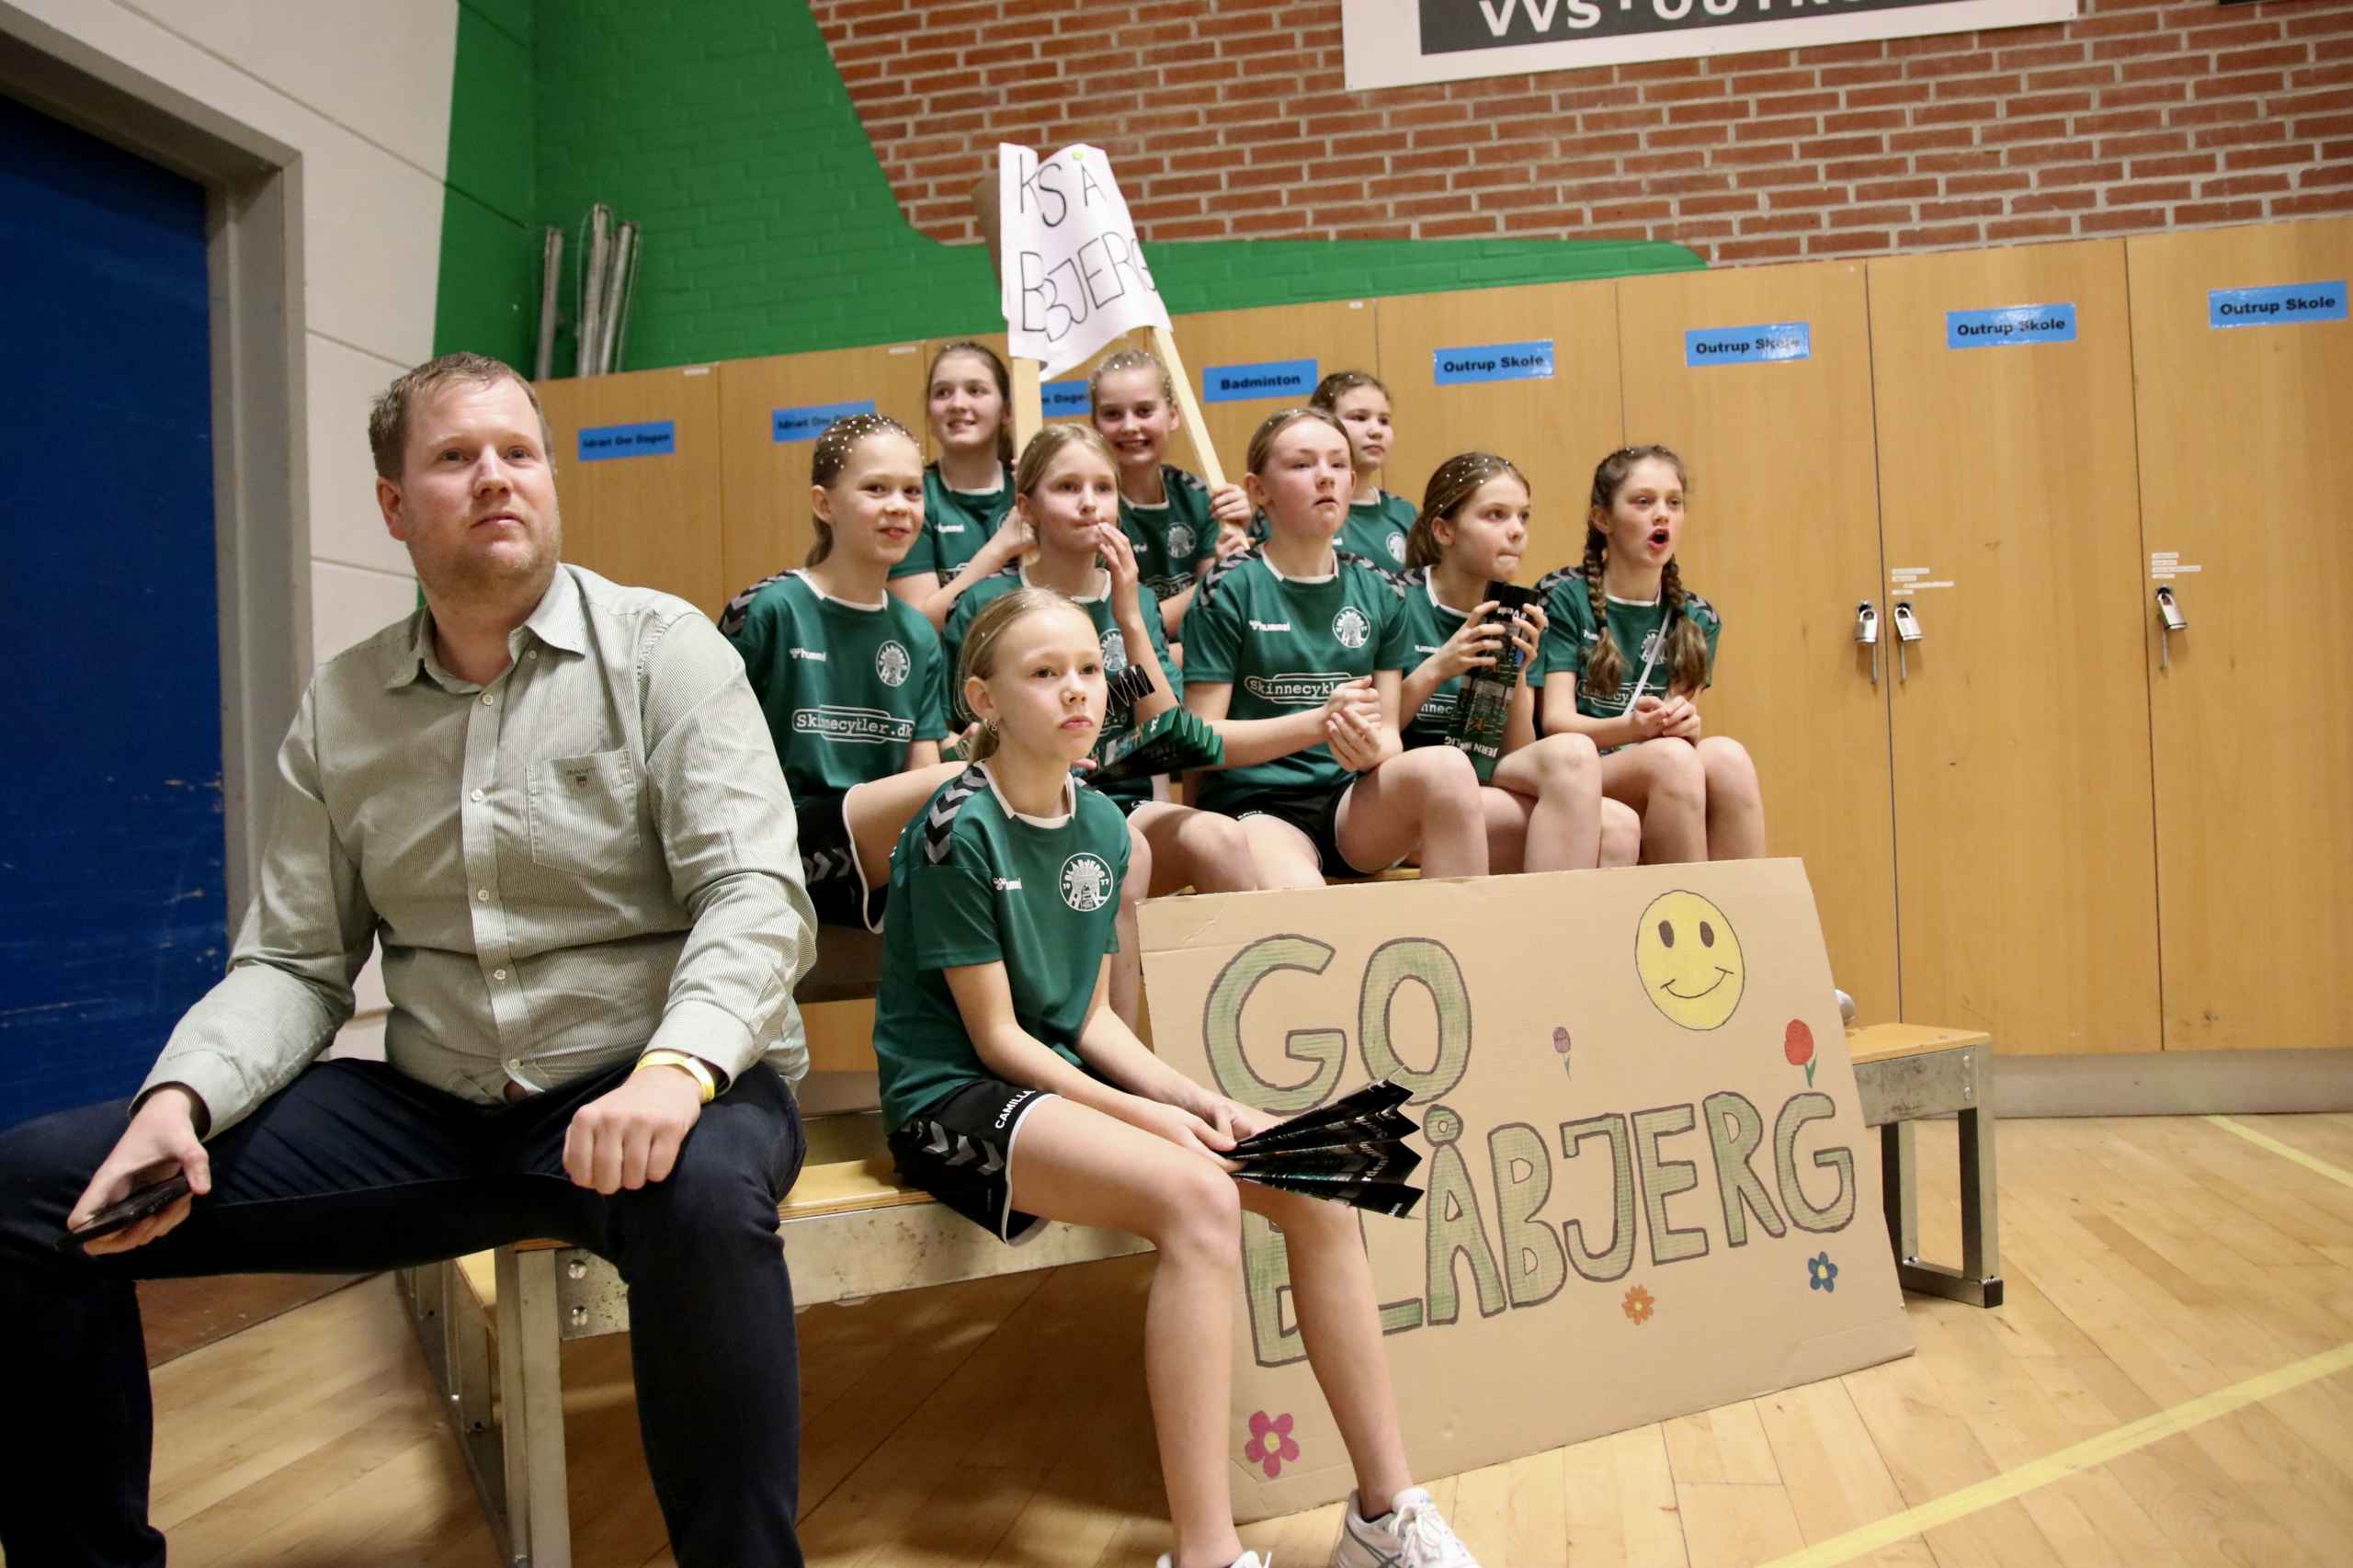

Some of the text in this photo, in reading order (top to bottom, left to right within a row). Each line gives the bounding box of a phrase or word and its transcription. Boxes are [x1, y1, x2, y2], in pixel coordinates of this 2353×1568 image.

[2220, 295, 2336, 316] Outrup Skole
[1956, 317, 2066, 336] Outrup Skole
[1695, 341, 1751, 355] Outrup
[1443, 355, 1544, 373] Outrup Skole
[1220, 375, 1302, 391] Badminton
[1201, 933, 1472, 1114] GO
[1239, 1090, 1857, 1369] ÅBJERG
